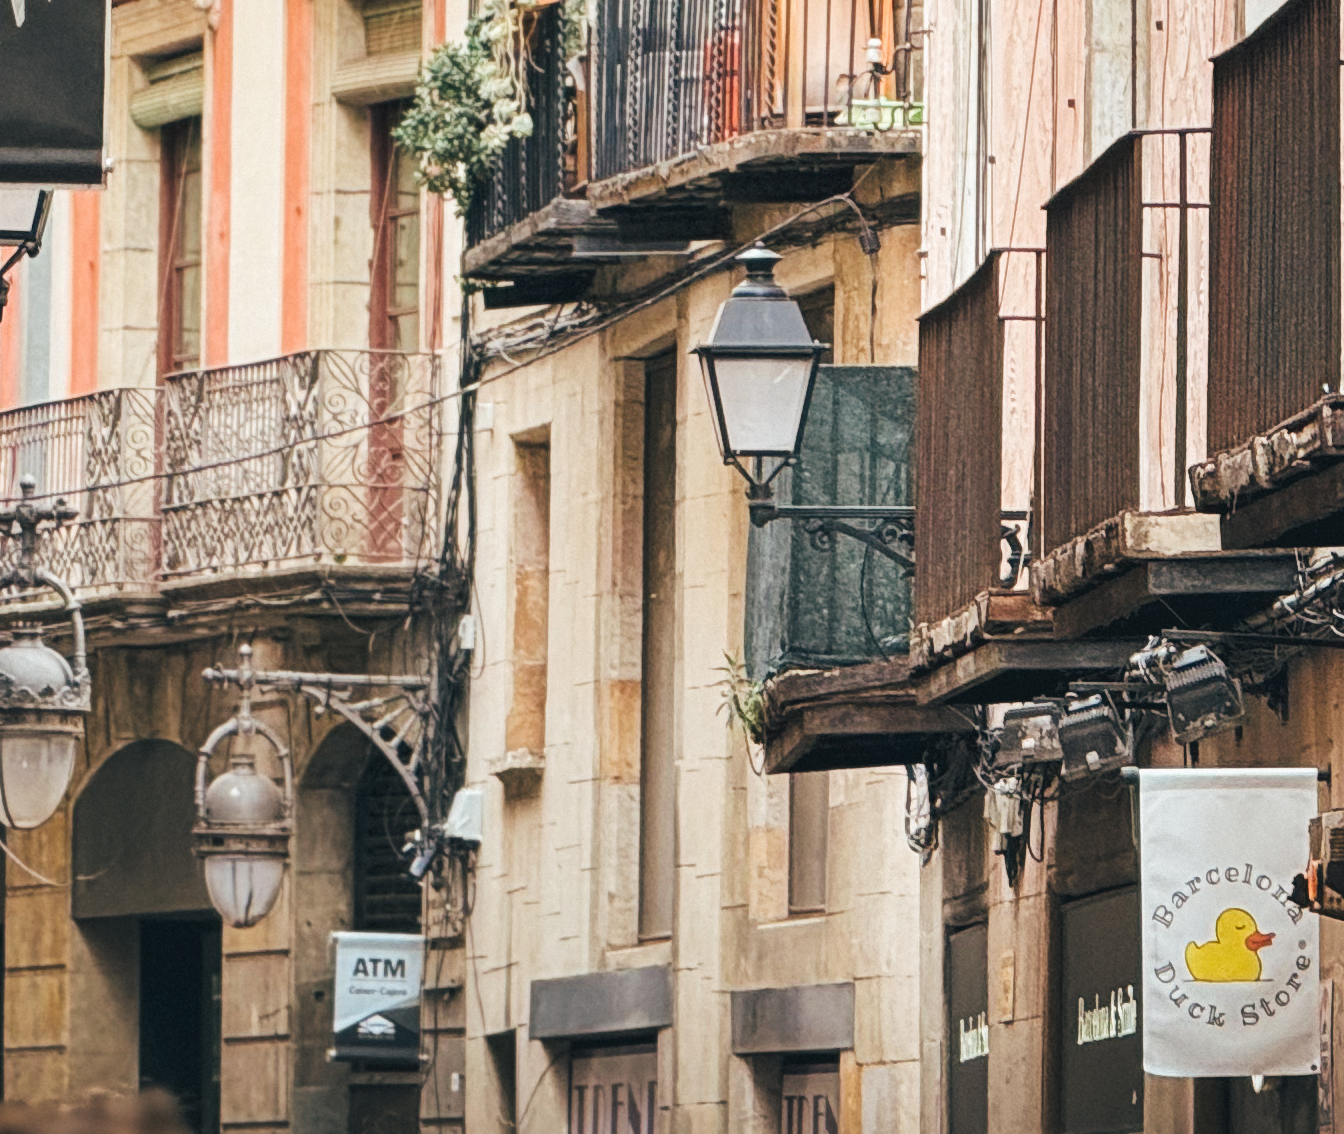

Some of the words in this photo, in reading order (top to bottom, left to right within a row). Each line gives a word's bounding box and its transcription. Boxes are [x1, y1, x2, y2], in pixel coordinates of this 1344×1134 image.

[1151, 862, 1304, 929] Barcelona
[352, 957, 406, 979] ATM
[1154, 961, 1226, 1028] Duck
[1240, 953, 1312, 1027] Store
